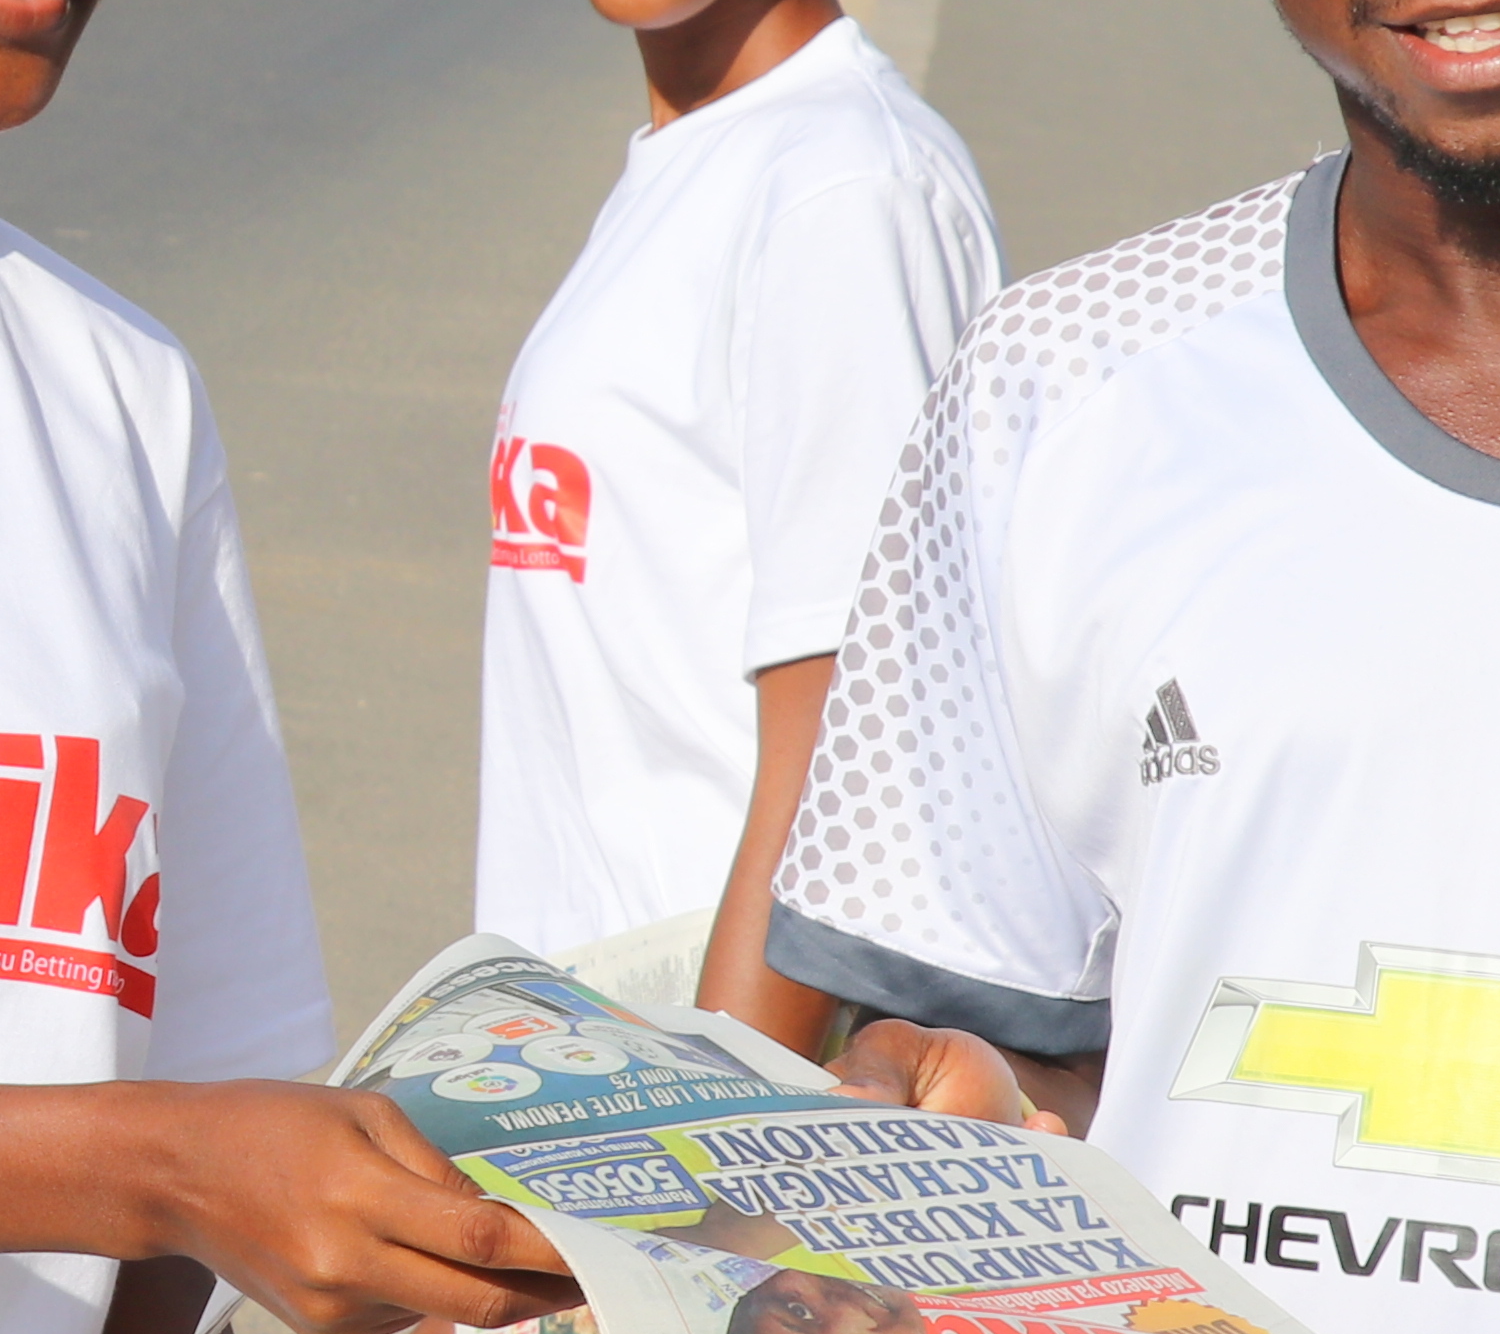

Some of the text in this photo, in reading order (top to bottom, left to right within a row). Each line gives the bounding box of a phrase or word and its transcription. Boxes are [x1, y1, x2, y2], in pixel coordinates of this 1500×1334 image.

[19, 949, 104, 991] Betting
[606, 1071, 638, 1089] 25
[644, 1083, 695, 1107] LIGI
[688, 1079, 772, 1099] KATIKA
[483, 1098, 588, 1131] PENDWA.
[584, 1090, 647, 1116] ZOTE
[686, 1120, 1024, 1168] MABILIONI
[529, 1157, 683, 1205] 505050
[704, 1150, 1066, 1217] ZACHANGIA
[786, 1191, 1109, 1252] ZA KUBETI
[847, 1235, 1155, 1287] KAMPUNI
[1072, 1278, 1103, 1300] ya
[1101, 1271, 1189, 1298] Michezo
